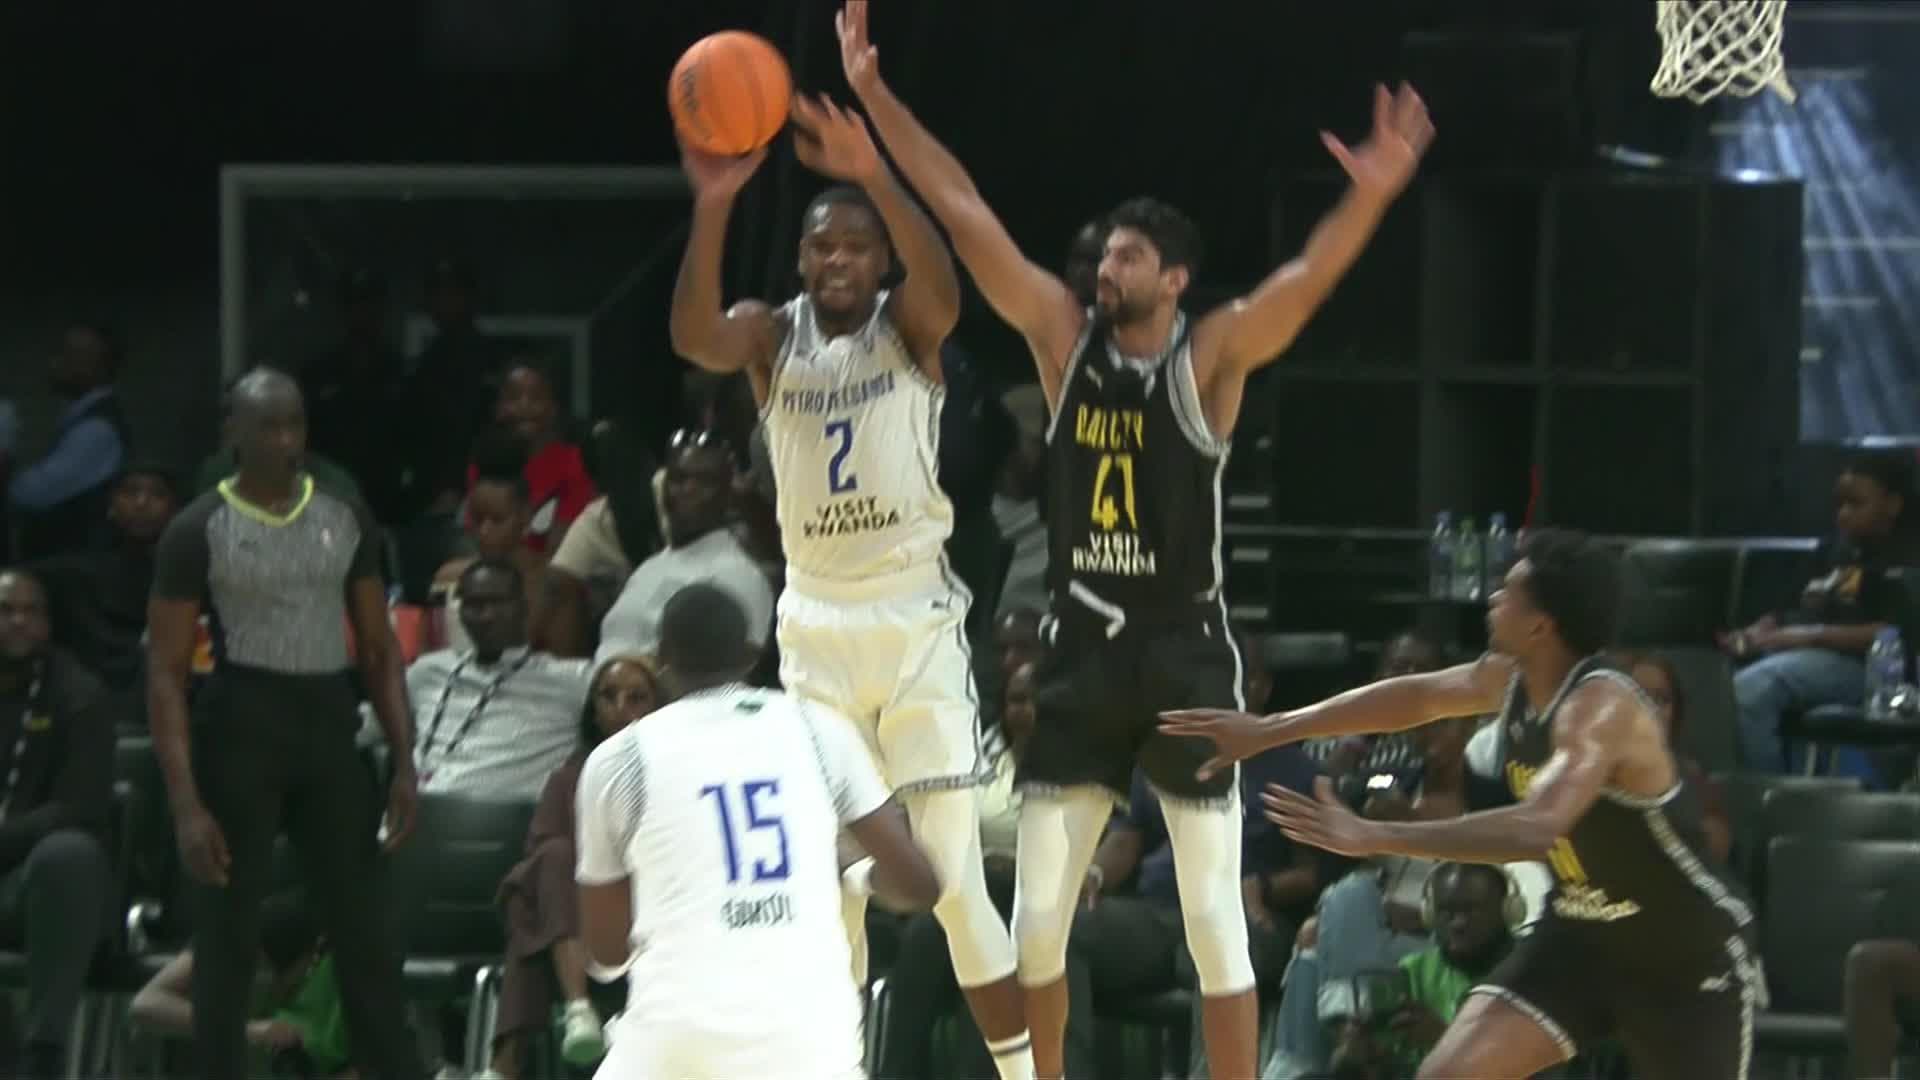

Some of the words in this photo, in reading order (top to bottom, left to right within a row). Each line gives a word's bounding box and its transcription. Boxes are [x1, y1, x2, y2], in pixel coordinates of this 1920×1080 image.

[825, 416, 858, 496] 2
[803, 509, 900, 538] RWANDA
[816, 496, 878, 520] VISIT
[698, 778, 792, 885] 15
